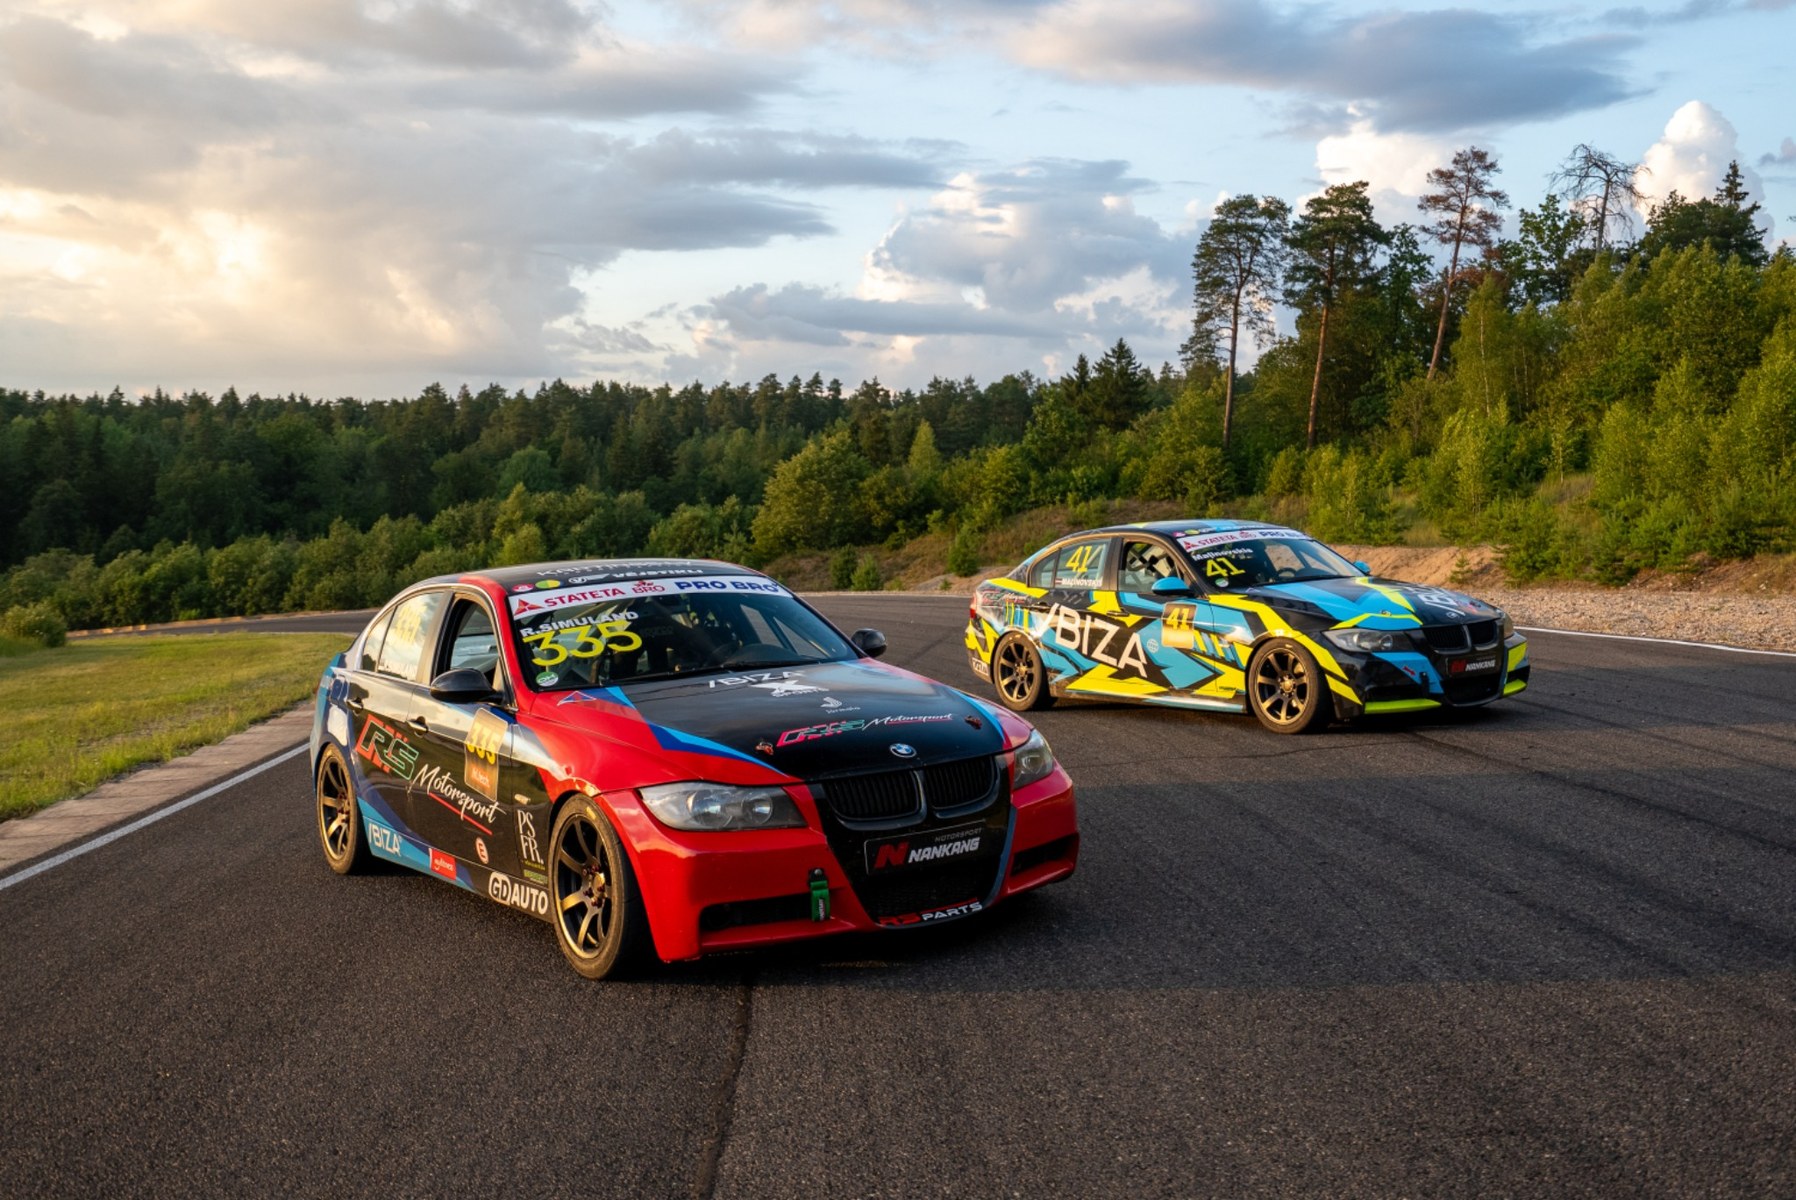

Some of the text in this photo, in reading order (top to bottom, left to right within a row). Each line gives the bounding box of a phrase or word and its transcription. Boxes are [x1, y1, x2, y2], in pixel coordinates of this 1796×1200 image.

[1065, 546, 1093, 573] 41
[1205, 556, 1246, 578] 41
[543, 586, 627, 608] STATETA
[674, 580, 728, 591] PRO
[518, 610, 640, 638] R.SIMULAND
[1165, 607, 1190, 631] 41
[521, 619, 643, 667] 335
[1036, 602, 1149, 678] IBIZA
[466, 721, 503, 766] 335
[354, 713, 507, 824] RS Motorsport
[516, 809, 537, 839] PS
[907, 837, 981, 864] NANKANG
[921, 901, 983, 921] PARTS
